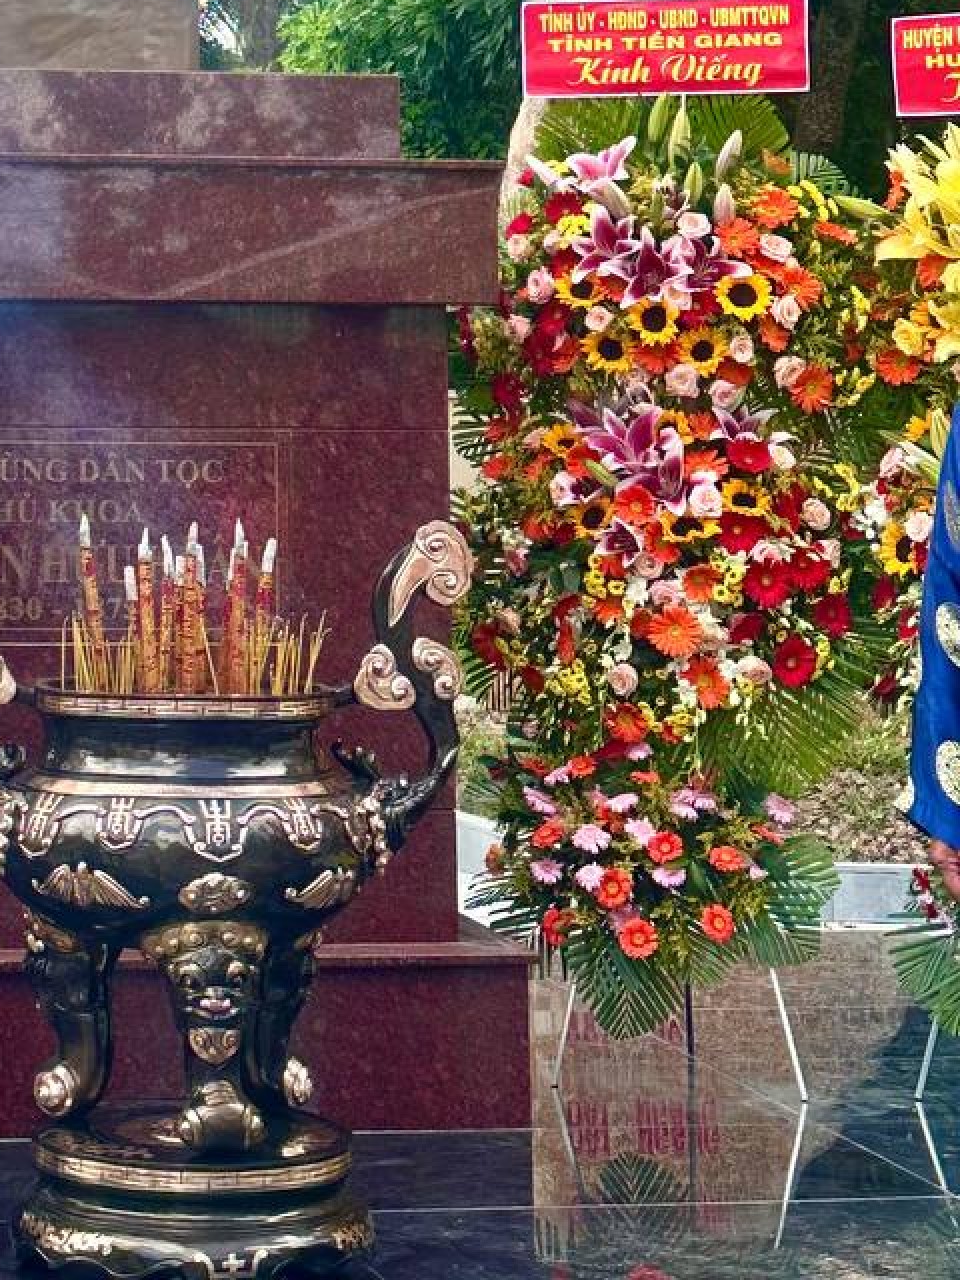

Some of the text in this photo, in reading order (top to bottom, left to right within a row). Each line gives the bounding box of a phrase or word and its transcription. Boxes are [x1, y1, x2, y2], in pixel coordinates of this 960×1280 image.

[539, 5, 573, 32] TỈNH
[576, 5, 596, 31] ỦY
[659, 9, 698, 29] UBND
[709, 4, 789, 27] UBMTTQVN
[547, 33, 613, 52] TỈNH
[693, 32, 783, 49] GIANG
[903, 22, 953, 52] HUYỆN
[566, 53, 762, 87] Kính Viếng
